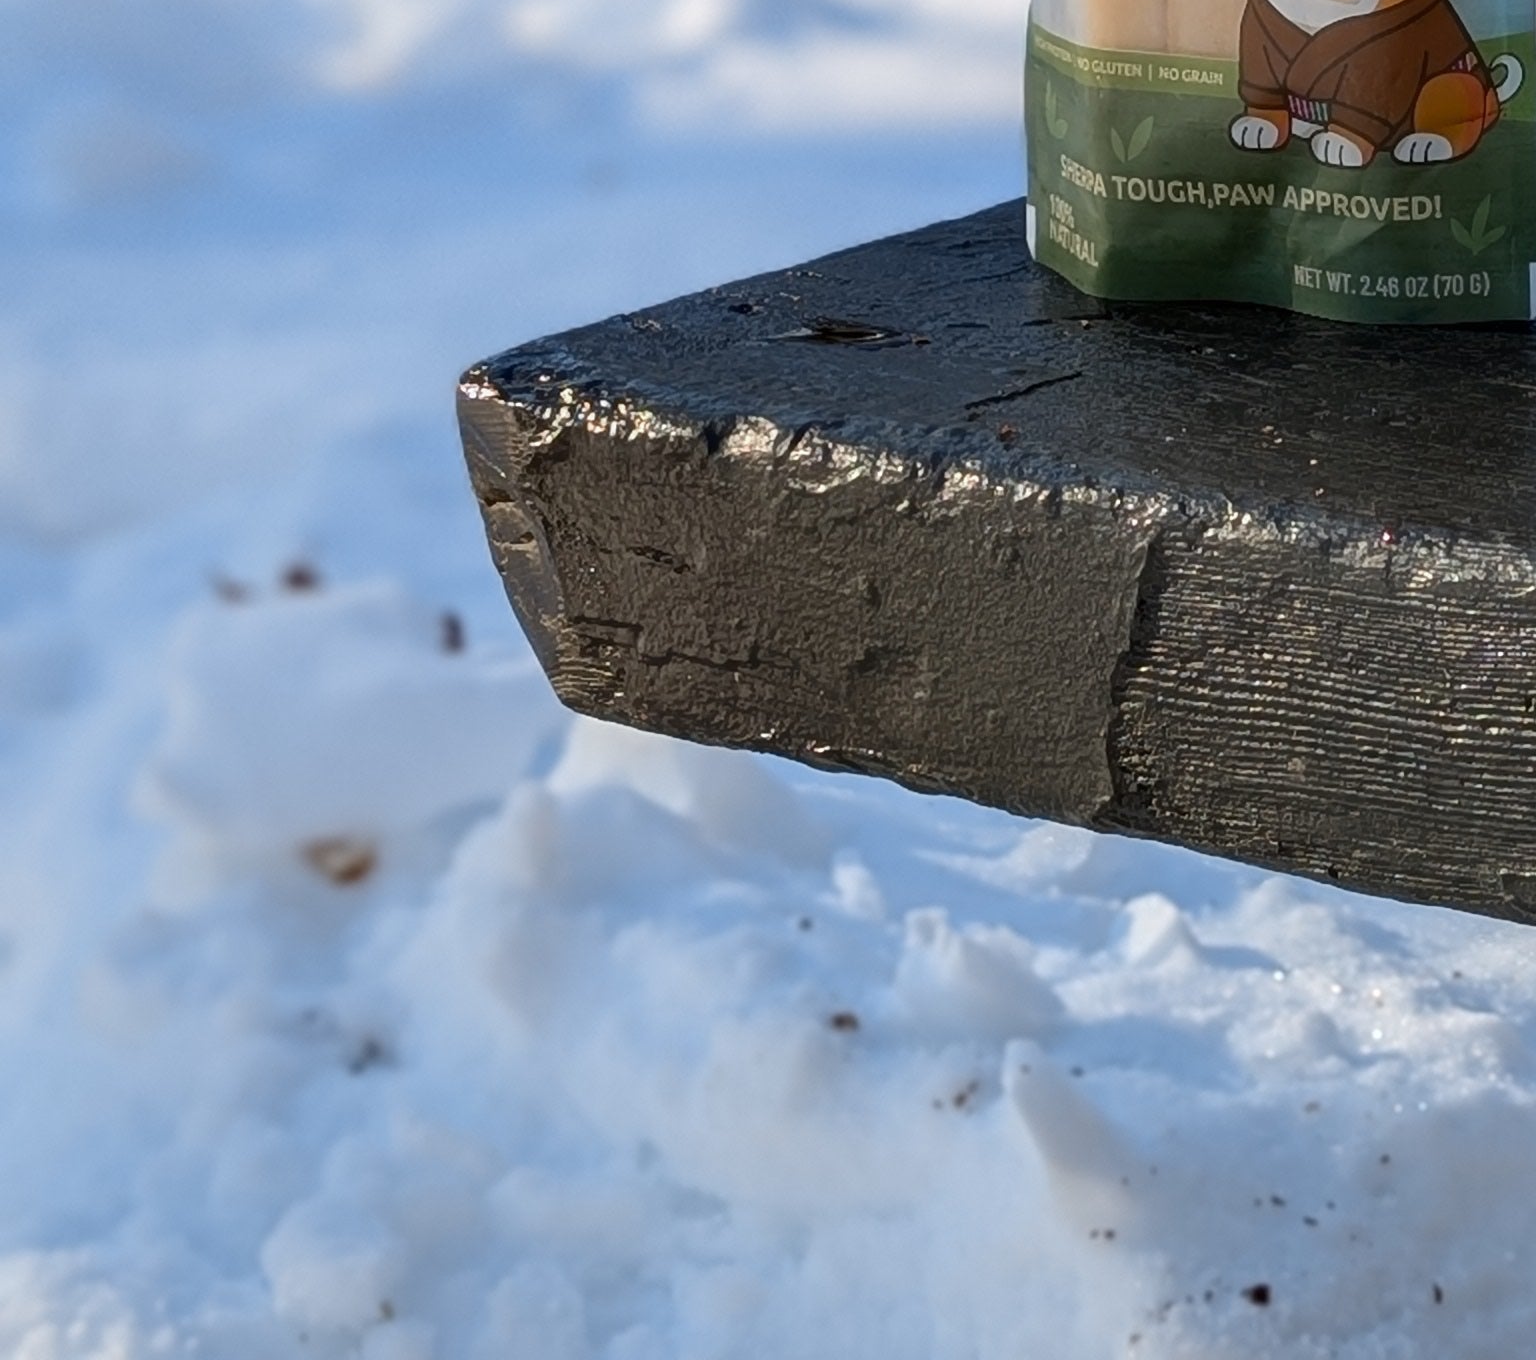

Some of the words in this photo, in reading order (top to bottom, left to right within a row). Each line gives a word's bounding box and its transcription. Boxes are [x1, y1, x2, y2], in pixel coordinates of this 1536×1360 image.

[1091, 59, 1142, 77] GLUTEN
[1159, 65, 1179, 80] NO
[1182, 68, 1223, 85] GRAIN
[1282, 185, 1442, 221] APPROVED!
[1293, 264, 1322, 289] NET
[1326, 270, 1357, 295] WT.
[1360, 275, 1400, 298] 2.46
[1405, 277, 1430, 298] OZ
[1433, 274, 1464, 299] (70
[1469, 271, 1491, 297] G)
